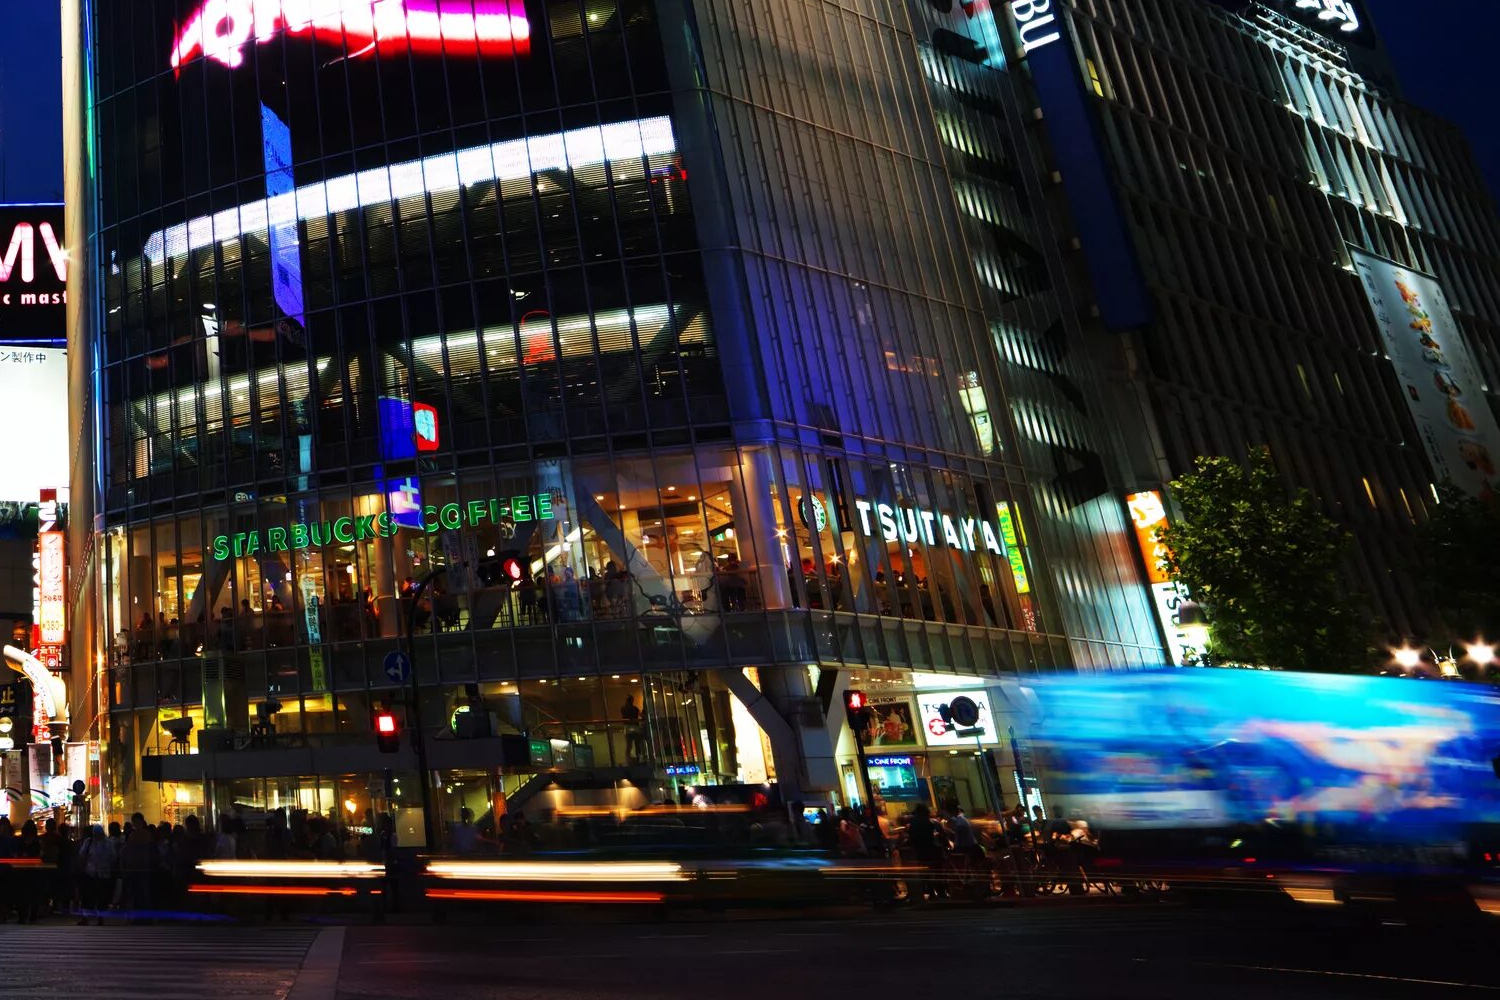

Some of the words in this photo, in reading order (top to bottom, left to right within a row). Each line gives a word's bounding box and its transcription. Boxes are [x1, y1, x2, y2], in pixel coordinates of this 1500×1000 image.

[213, 511, 399, 562] STARBUCKS
[418, 494, 554, 533] COFFEE
[856, 500, 1002, 556] TSUTAYA
